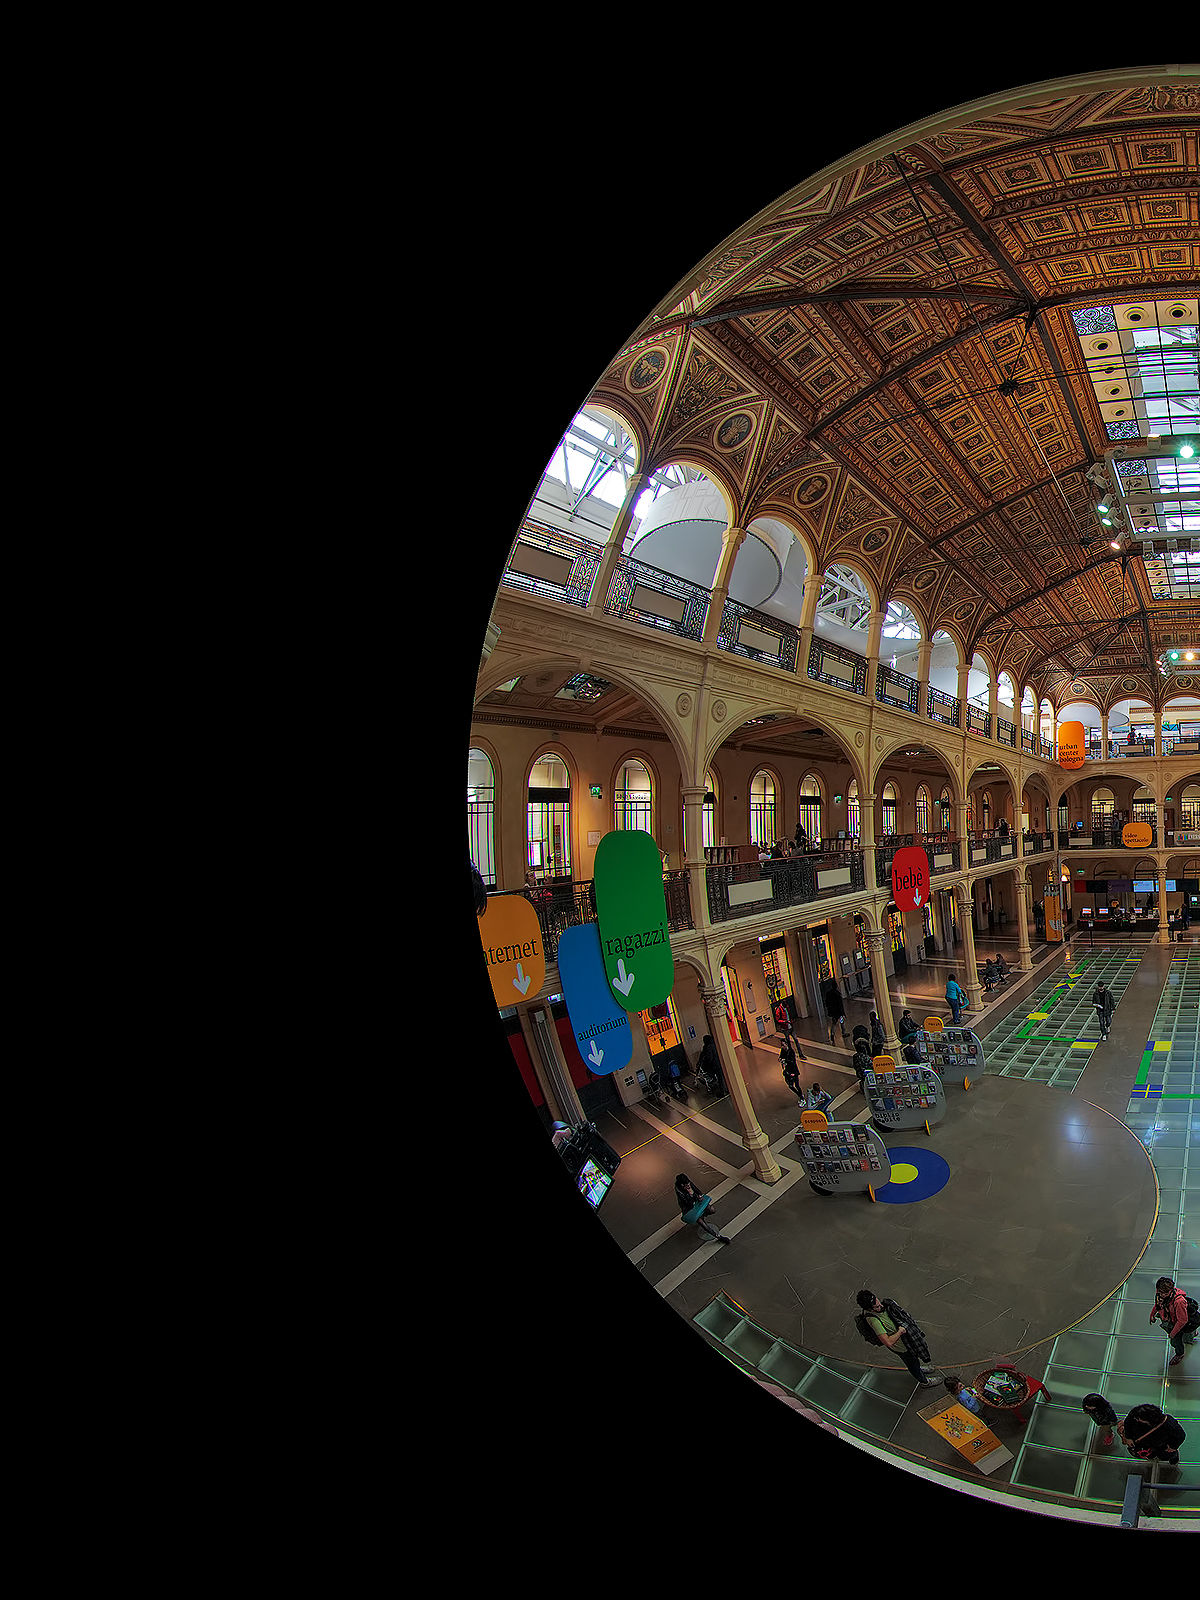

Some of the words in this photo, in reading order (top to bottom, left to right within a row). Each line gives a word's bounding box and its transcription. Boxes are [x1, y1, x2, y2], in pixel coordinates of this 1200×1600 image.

[1059, 743, 1078, 751] urban
[1059, 756, 1084, 764] bologna
[894, 866, 923, 891] bebè
[605, 921, 667, 958] ragazzi
[577, 1016, 627, 1041] auditorium
